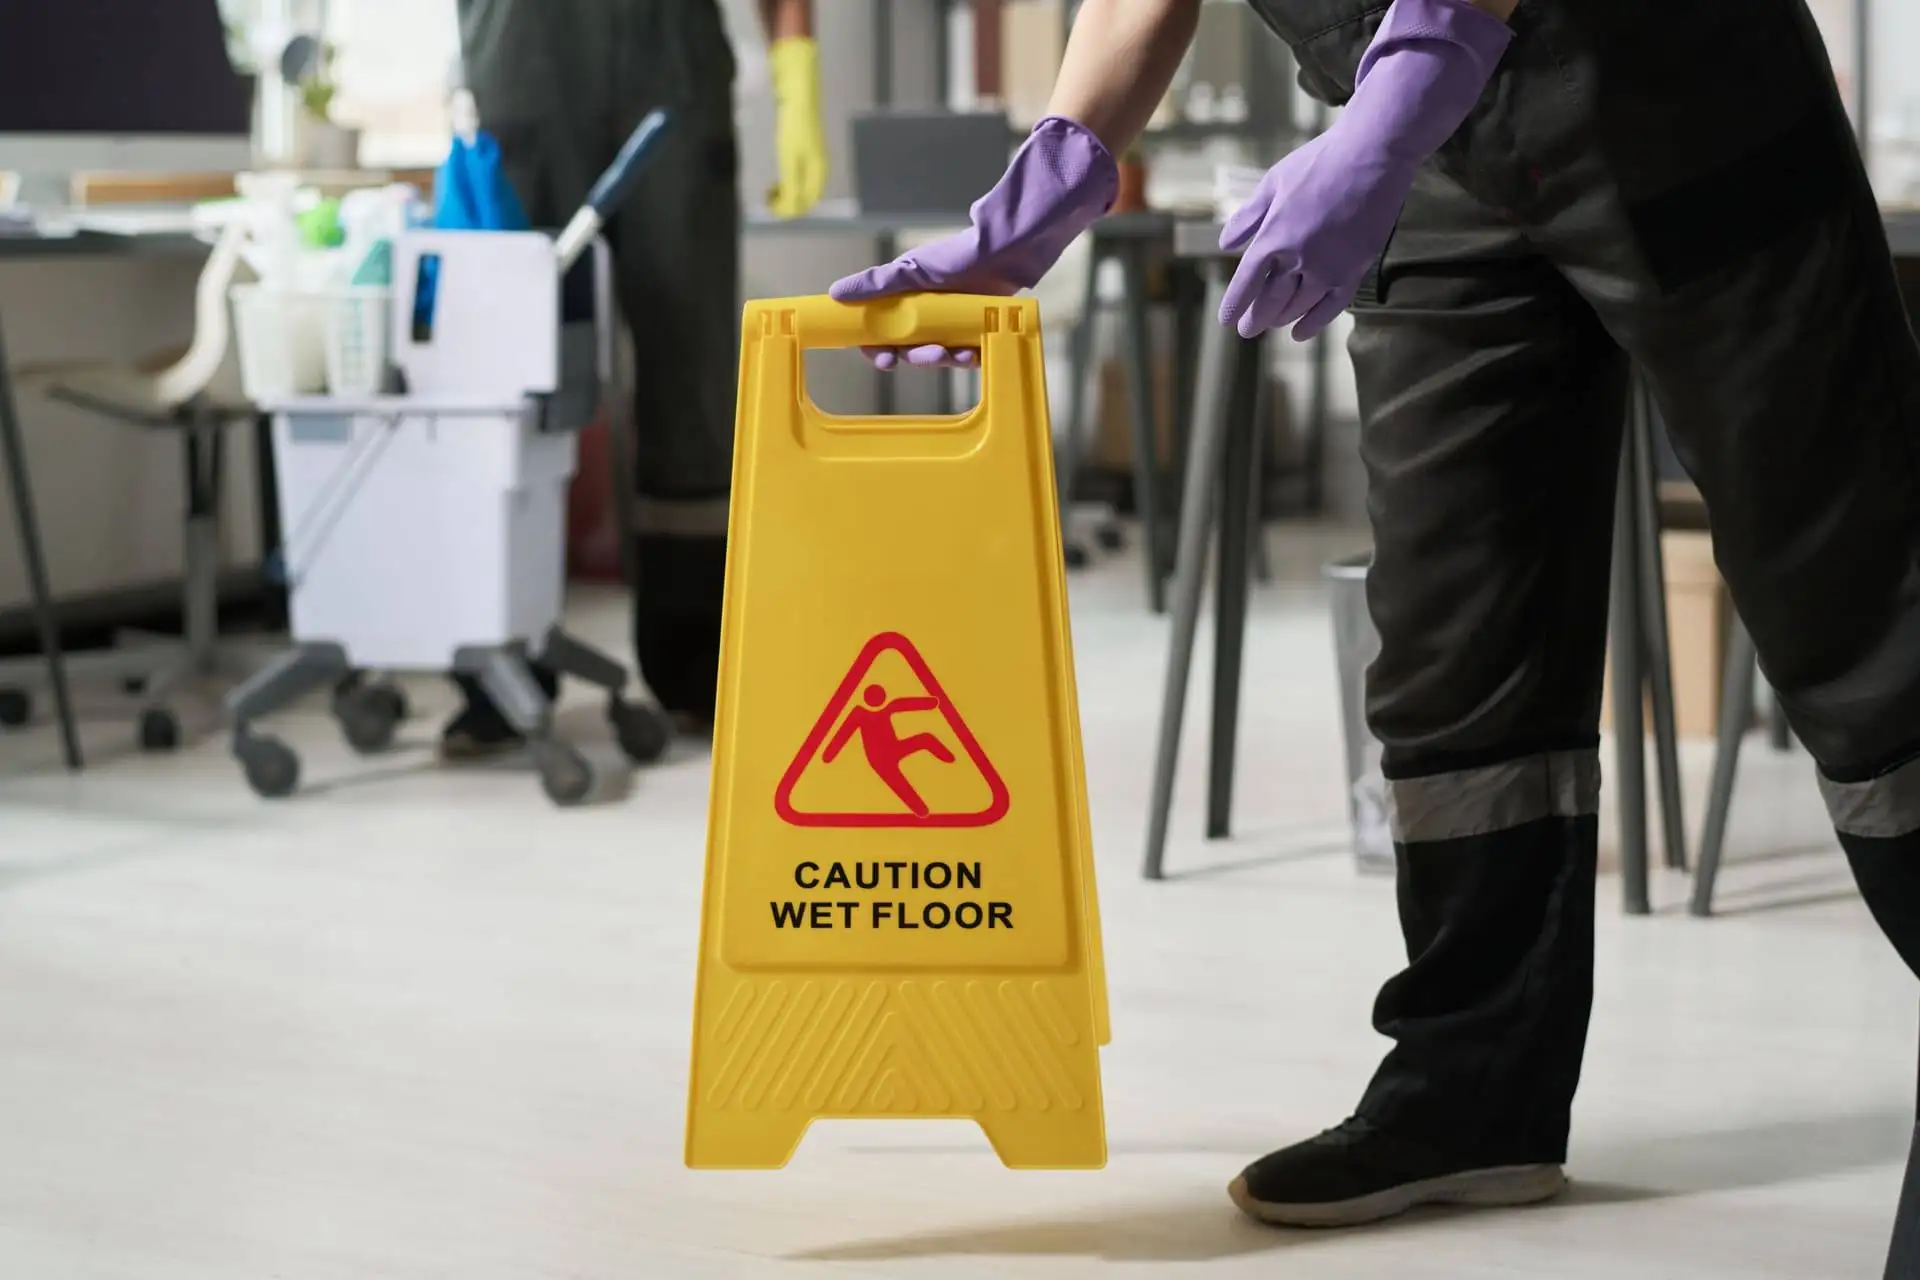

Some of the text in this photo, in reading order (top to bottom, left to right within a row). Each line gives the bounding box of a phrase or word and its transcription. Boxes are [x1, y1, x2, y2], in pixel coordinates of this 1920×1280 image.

[794, 861, 981, 890] CAUTION
[770, 901, 1014, 930] WET FLOOR
